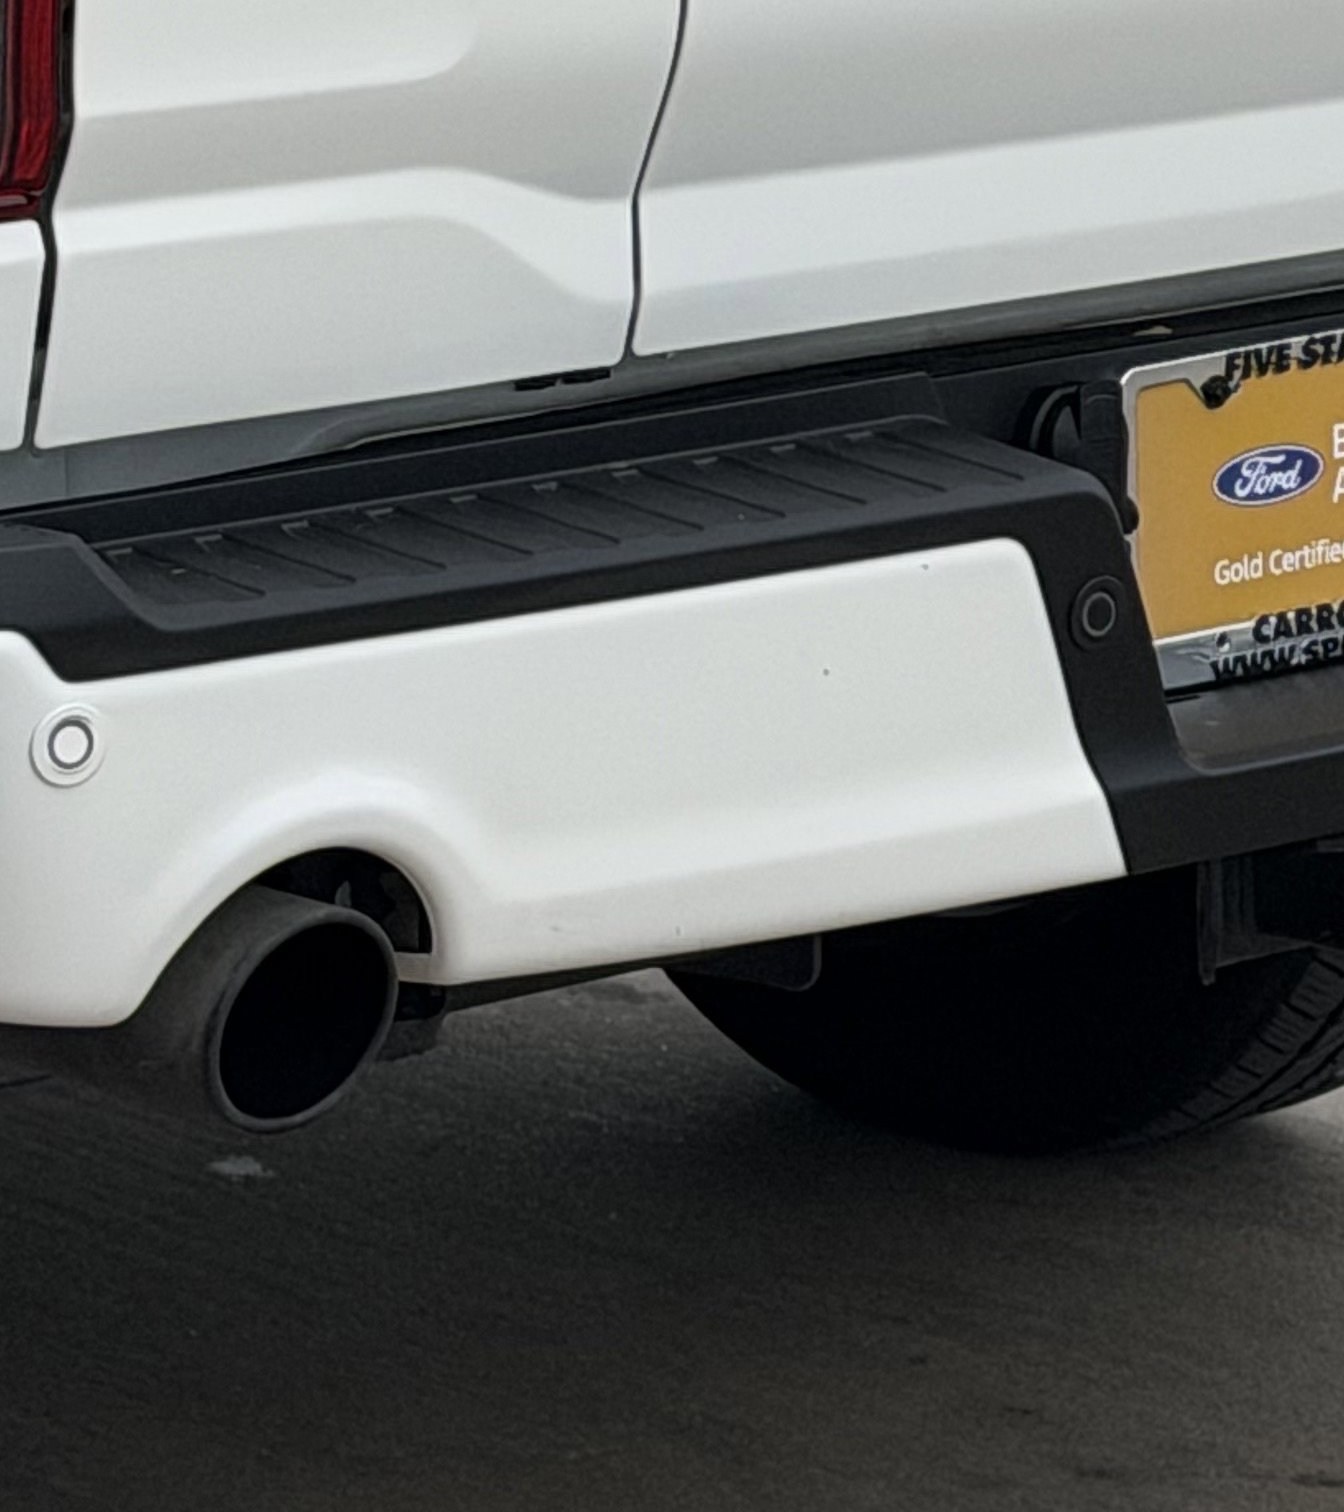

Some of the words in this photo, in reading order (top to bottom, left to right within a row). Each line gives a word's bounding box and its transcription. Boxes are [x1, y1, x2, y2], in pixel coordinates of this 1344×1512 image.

[1224, 343, 1292, 383] FIVE
[1233, 454, 1304, 499] Ford
[1214, 551, 1264, 586] Gold
